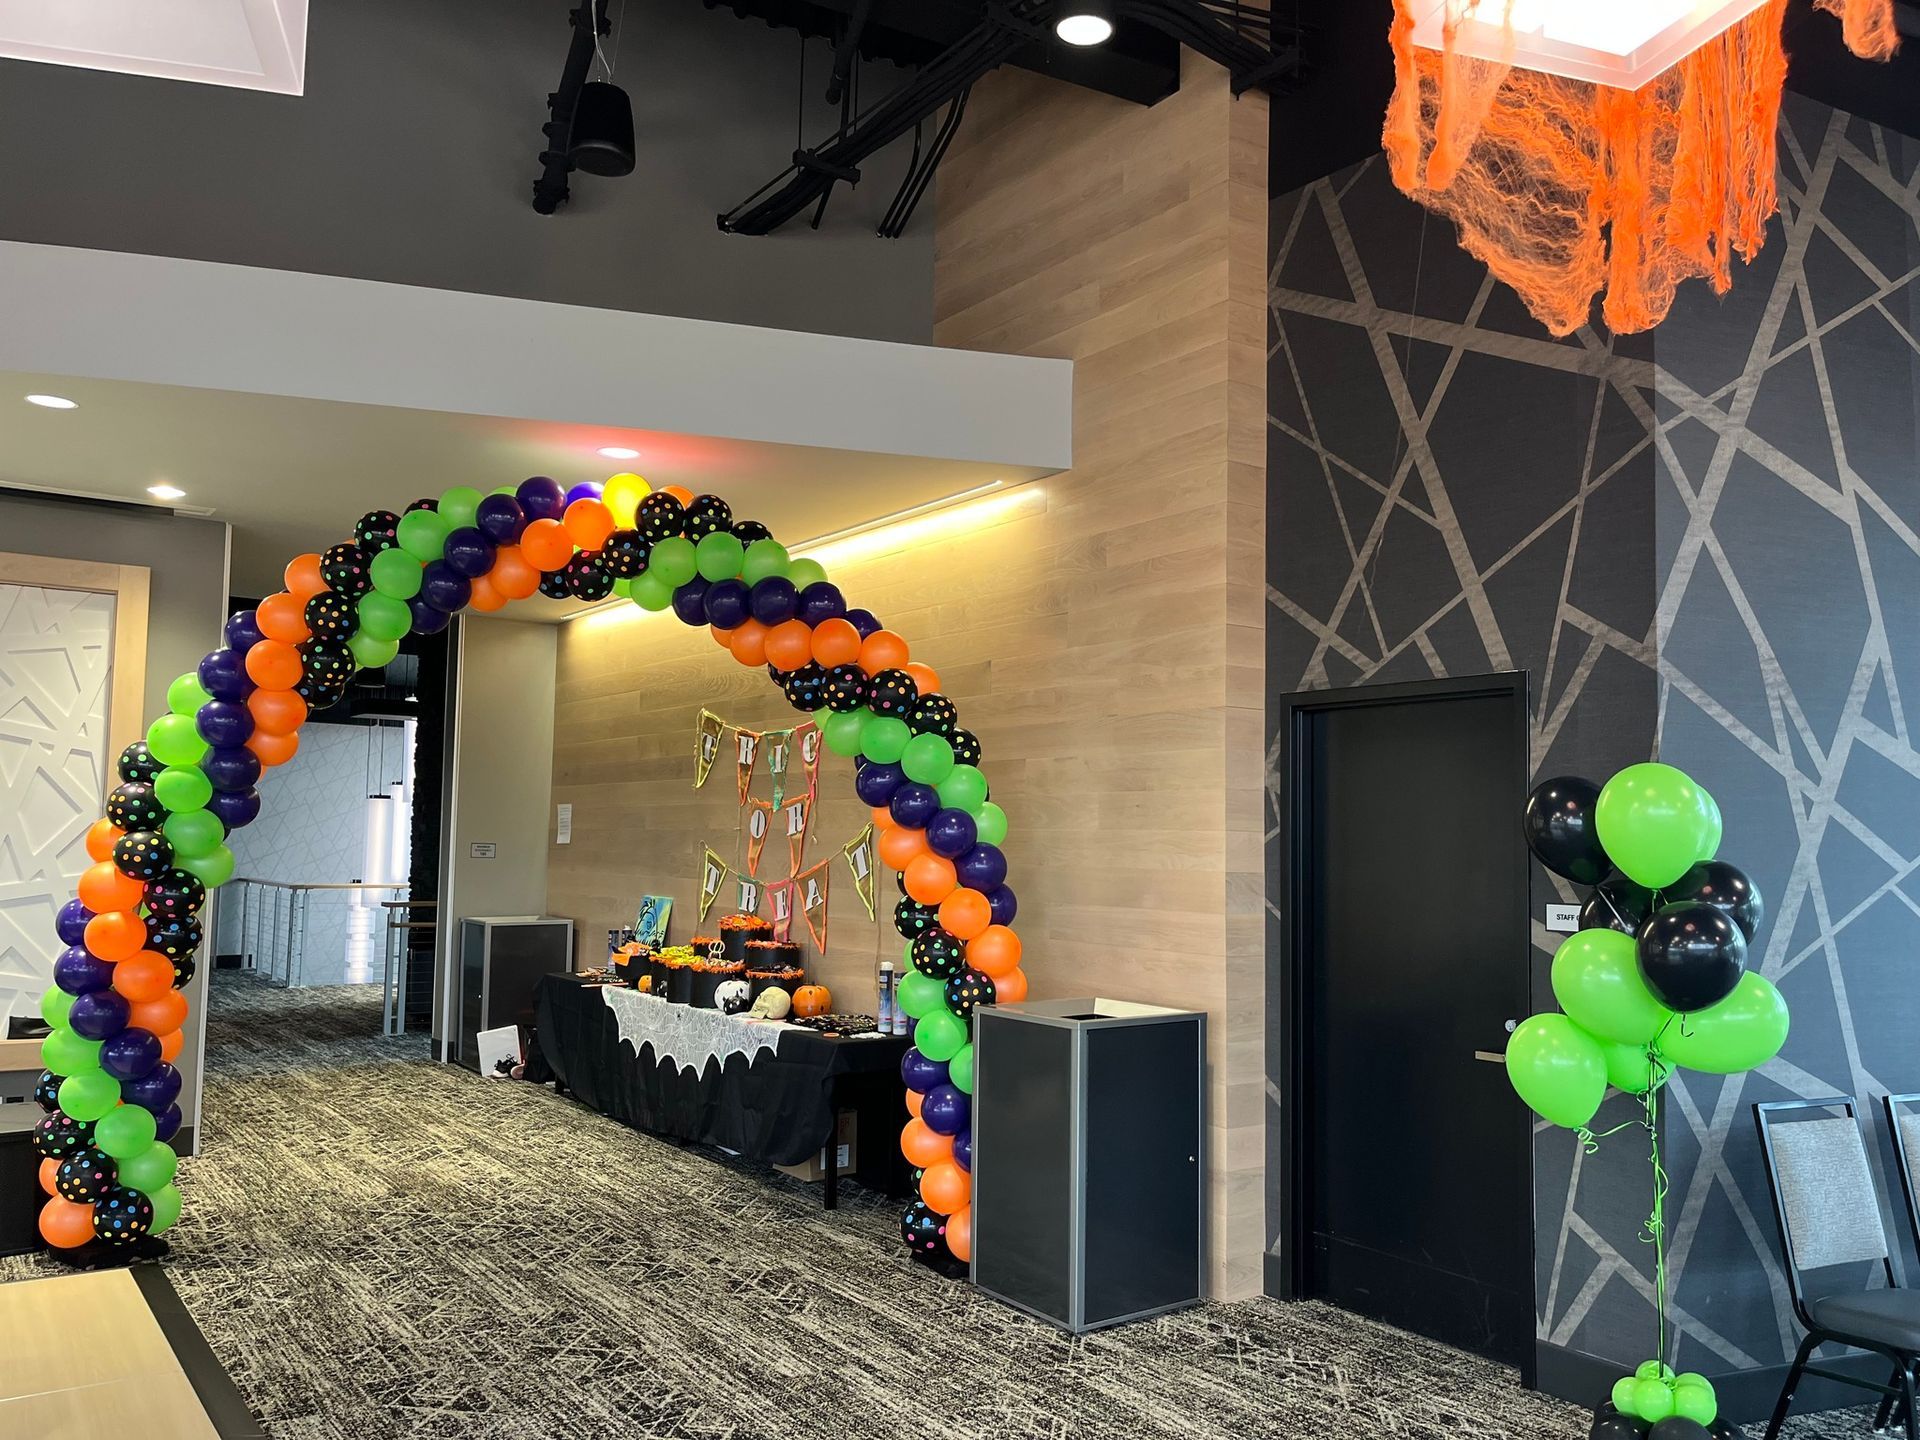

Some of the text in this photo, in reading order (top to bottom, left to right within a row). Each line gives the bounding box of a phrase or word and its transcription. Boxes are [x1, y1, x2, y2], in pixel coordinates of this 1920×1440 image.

[702, 731, 817, 773] TRIC
[751, 803, 803, 838] OR
[705, 843, 869, 921] TREAT
[1556, 913, 1575, 921] STAFF
